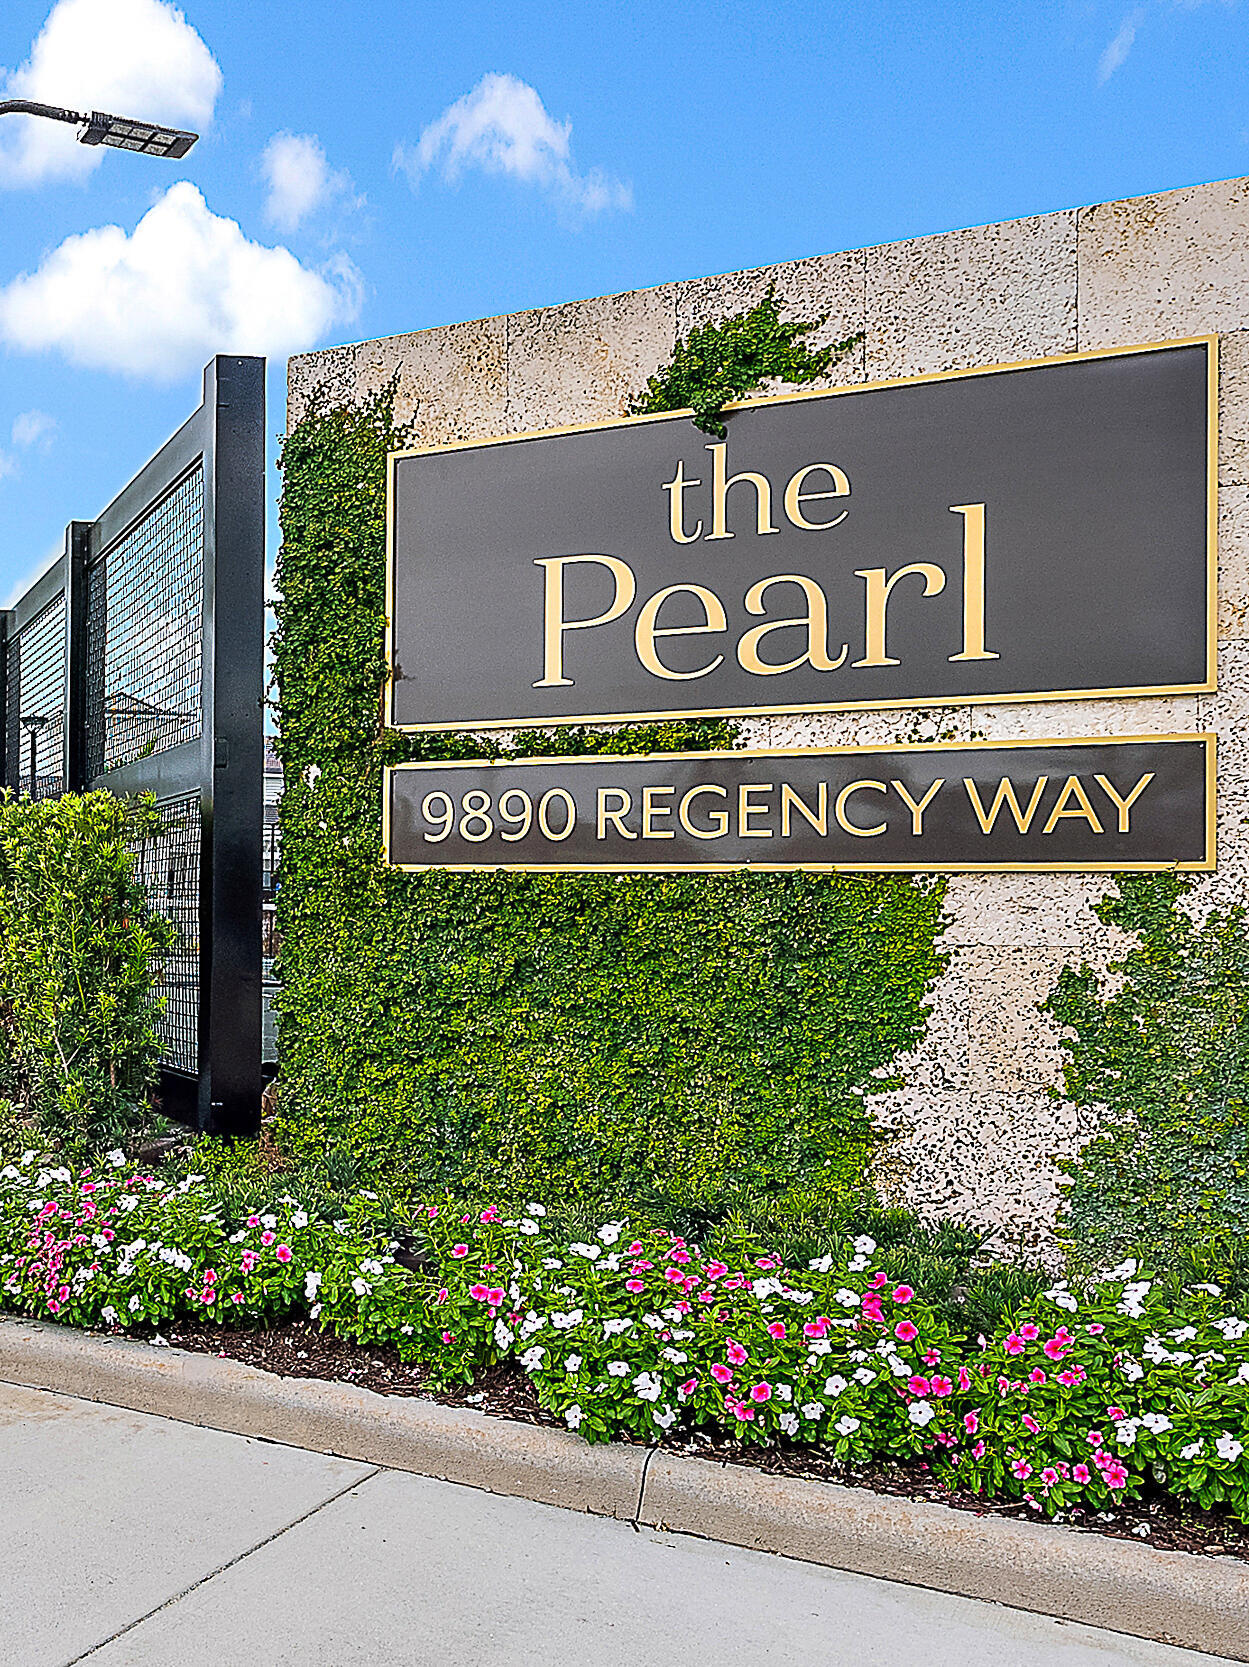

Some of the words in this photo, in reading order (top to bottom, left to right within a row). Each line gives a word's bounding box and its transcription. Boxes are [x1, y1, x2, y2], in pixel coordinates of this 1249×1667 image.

[661, 442, 852, 544] the
[532, 502, 1000, 688] Pearl
[421, 787, 577, 843] 9890
[596, 778, 946, 840] REGENCY
[962, 772, 1156, 835] WAY
